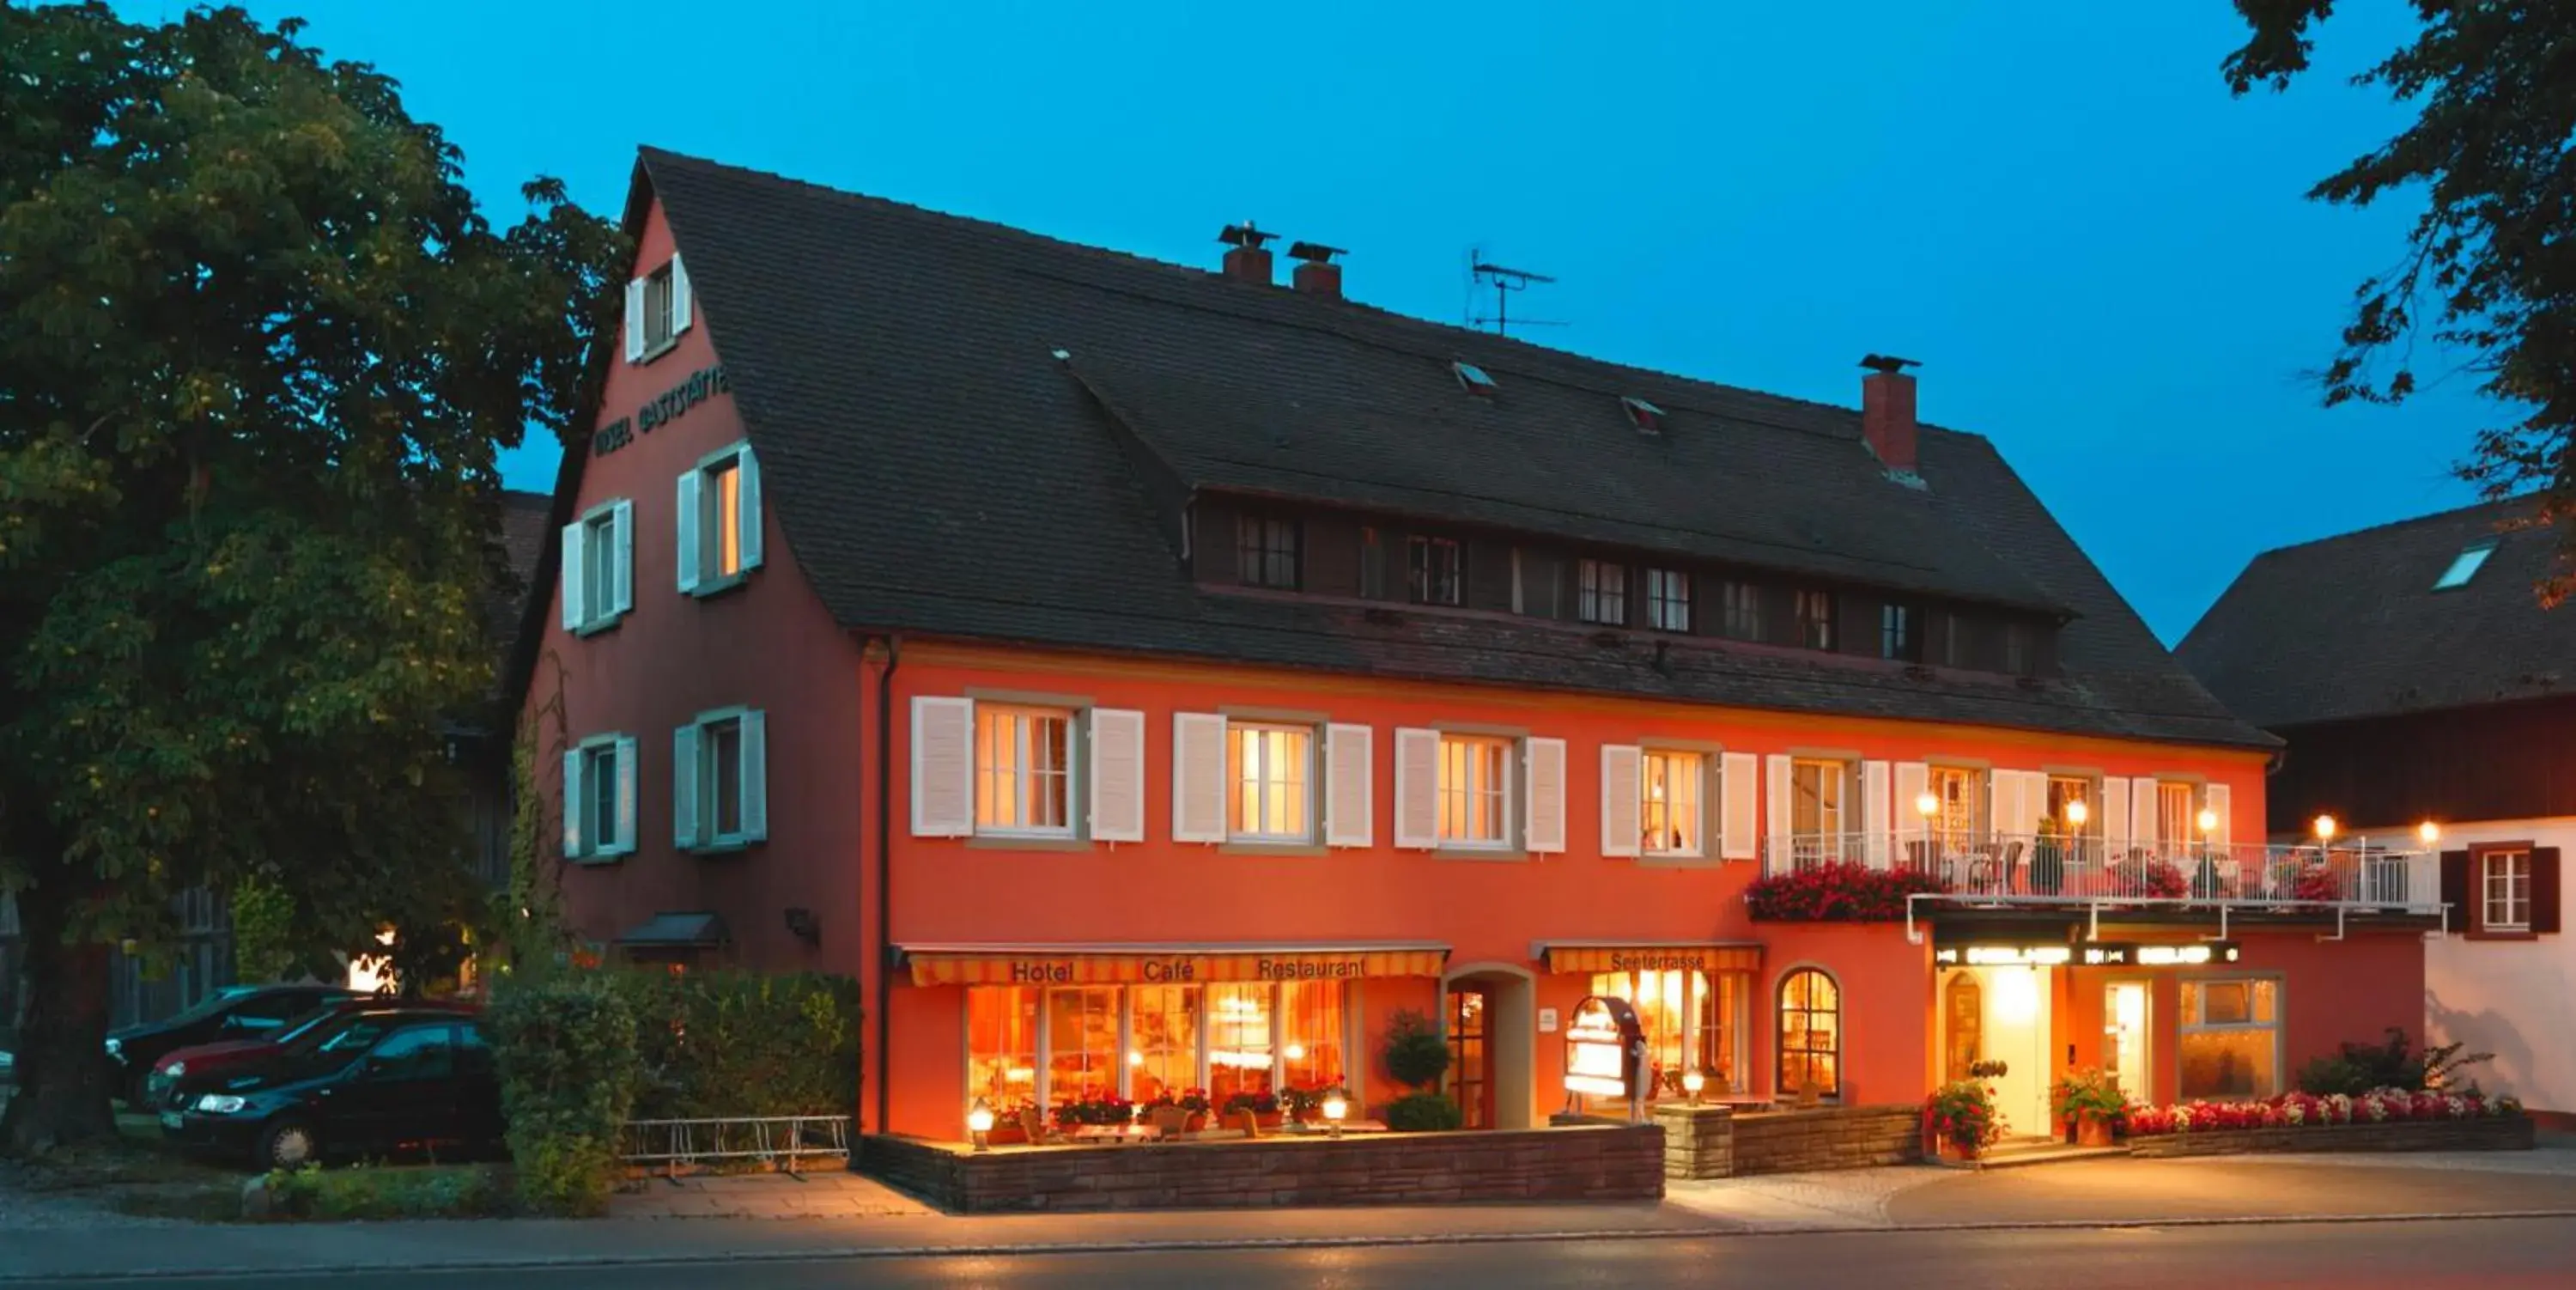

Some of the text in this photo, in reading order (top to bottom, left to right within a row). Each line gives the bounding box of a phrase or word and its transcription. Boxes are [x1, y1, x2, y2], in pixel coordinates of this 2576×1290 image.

[1012, 958, 1366, 982] Hotel Café Restaurant
[1611, 952, 1704, 971] Seeterrasse
